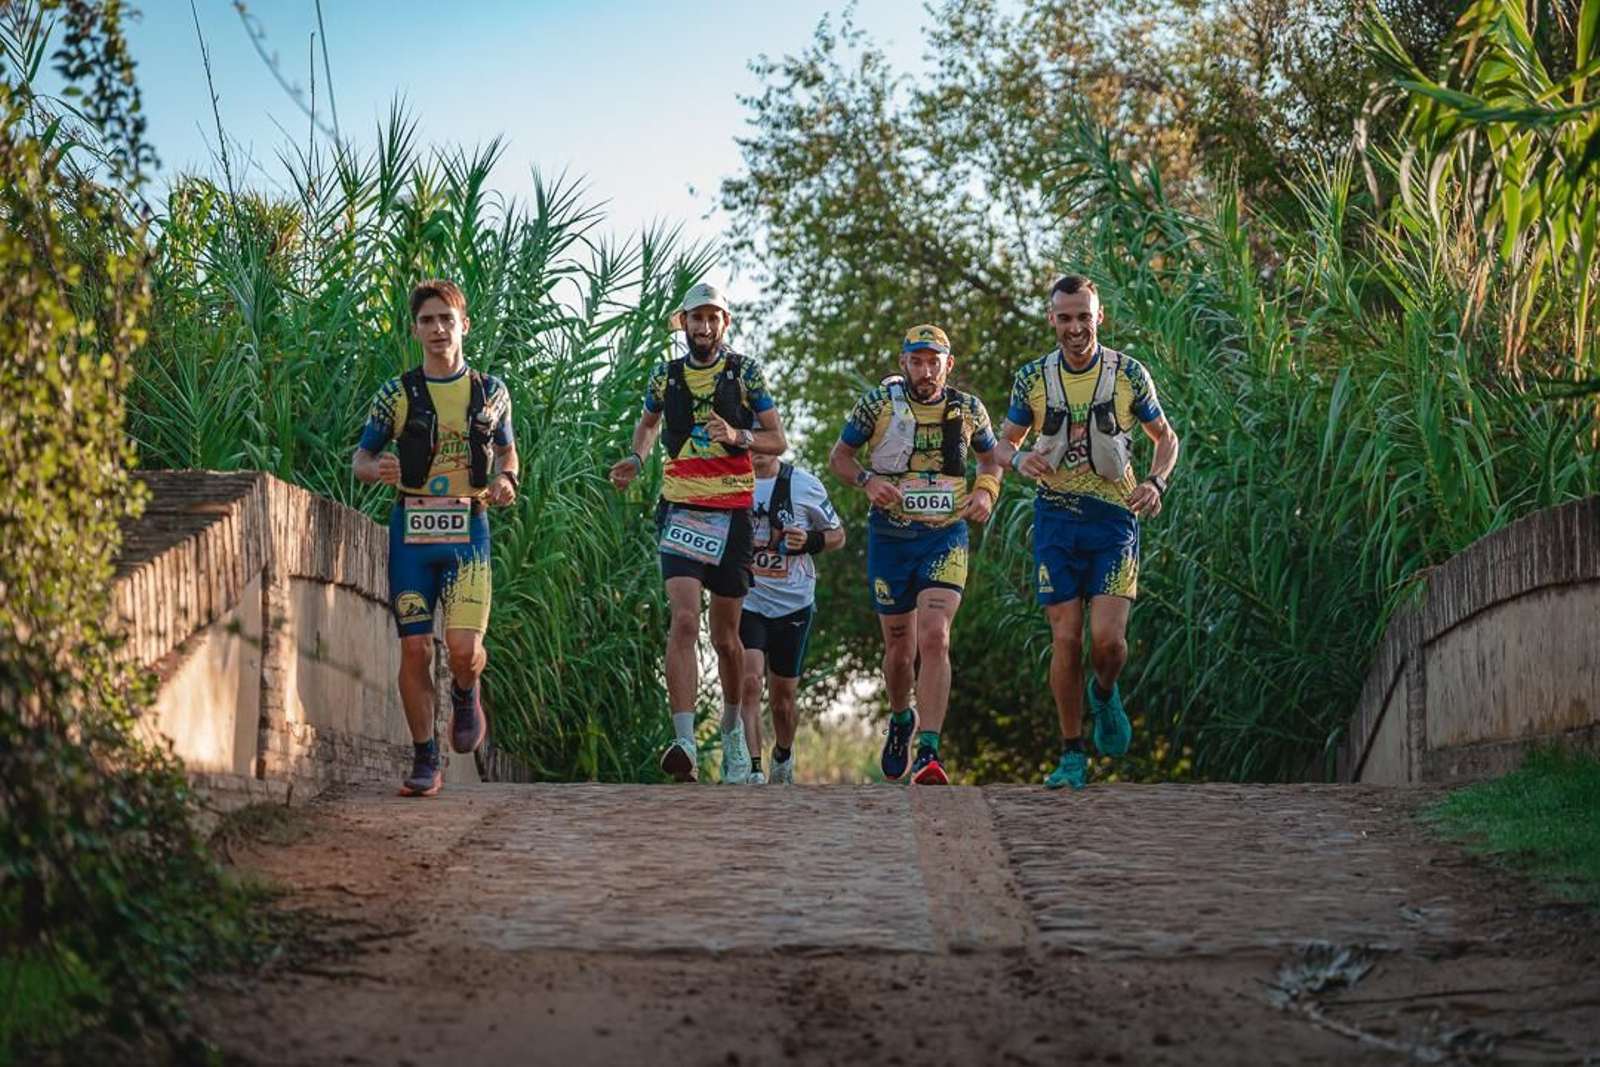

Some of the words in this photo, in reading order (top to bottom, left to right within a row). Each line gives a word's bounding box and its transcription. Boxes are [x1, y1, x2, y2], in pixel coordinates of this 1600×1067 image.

[905, 496, 951, 510] 606A
[410, 515, 464, 530] 606D
[670, 528, 720, 553] 606C
[752, 553, 782, 569] 02
